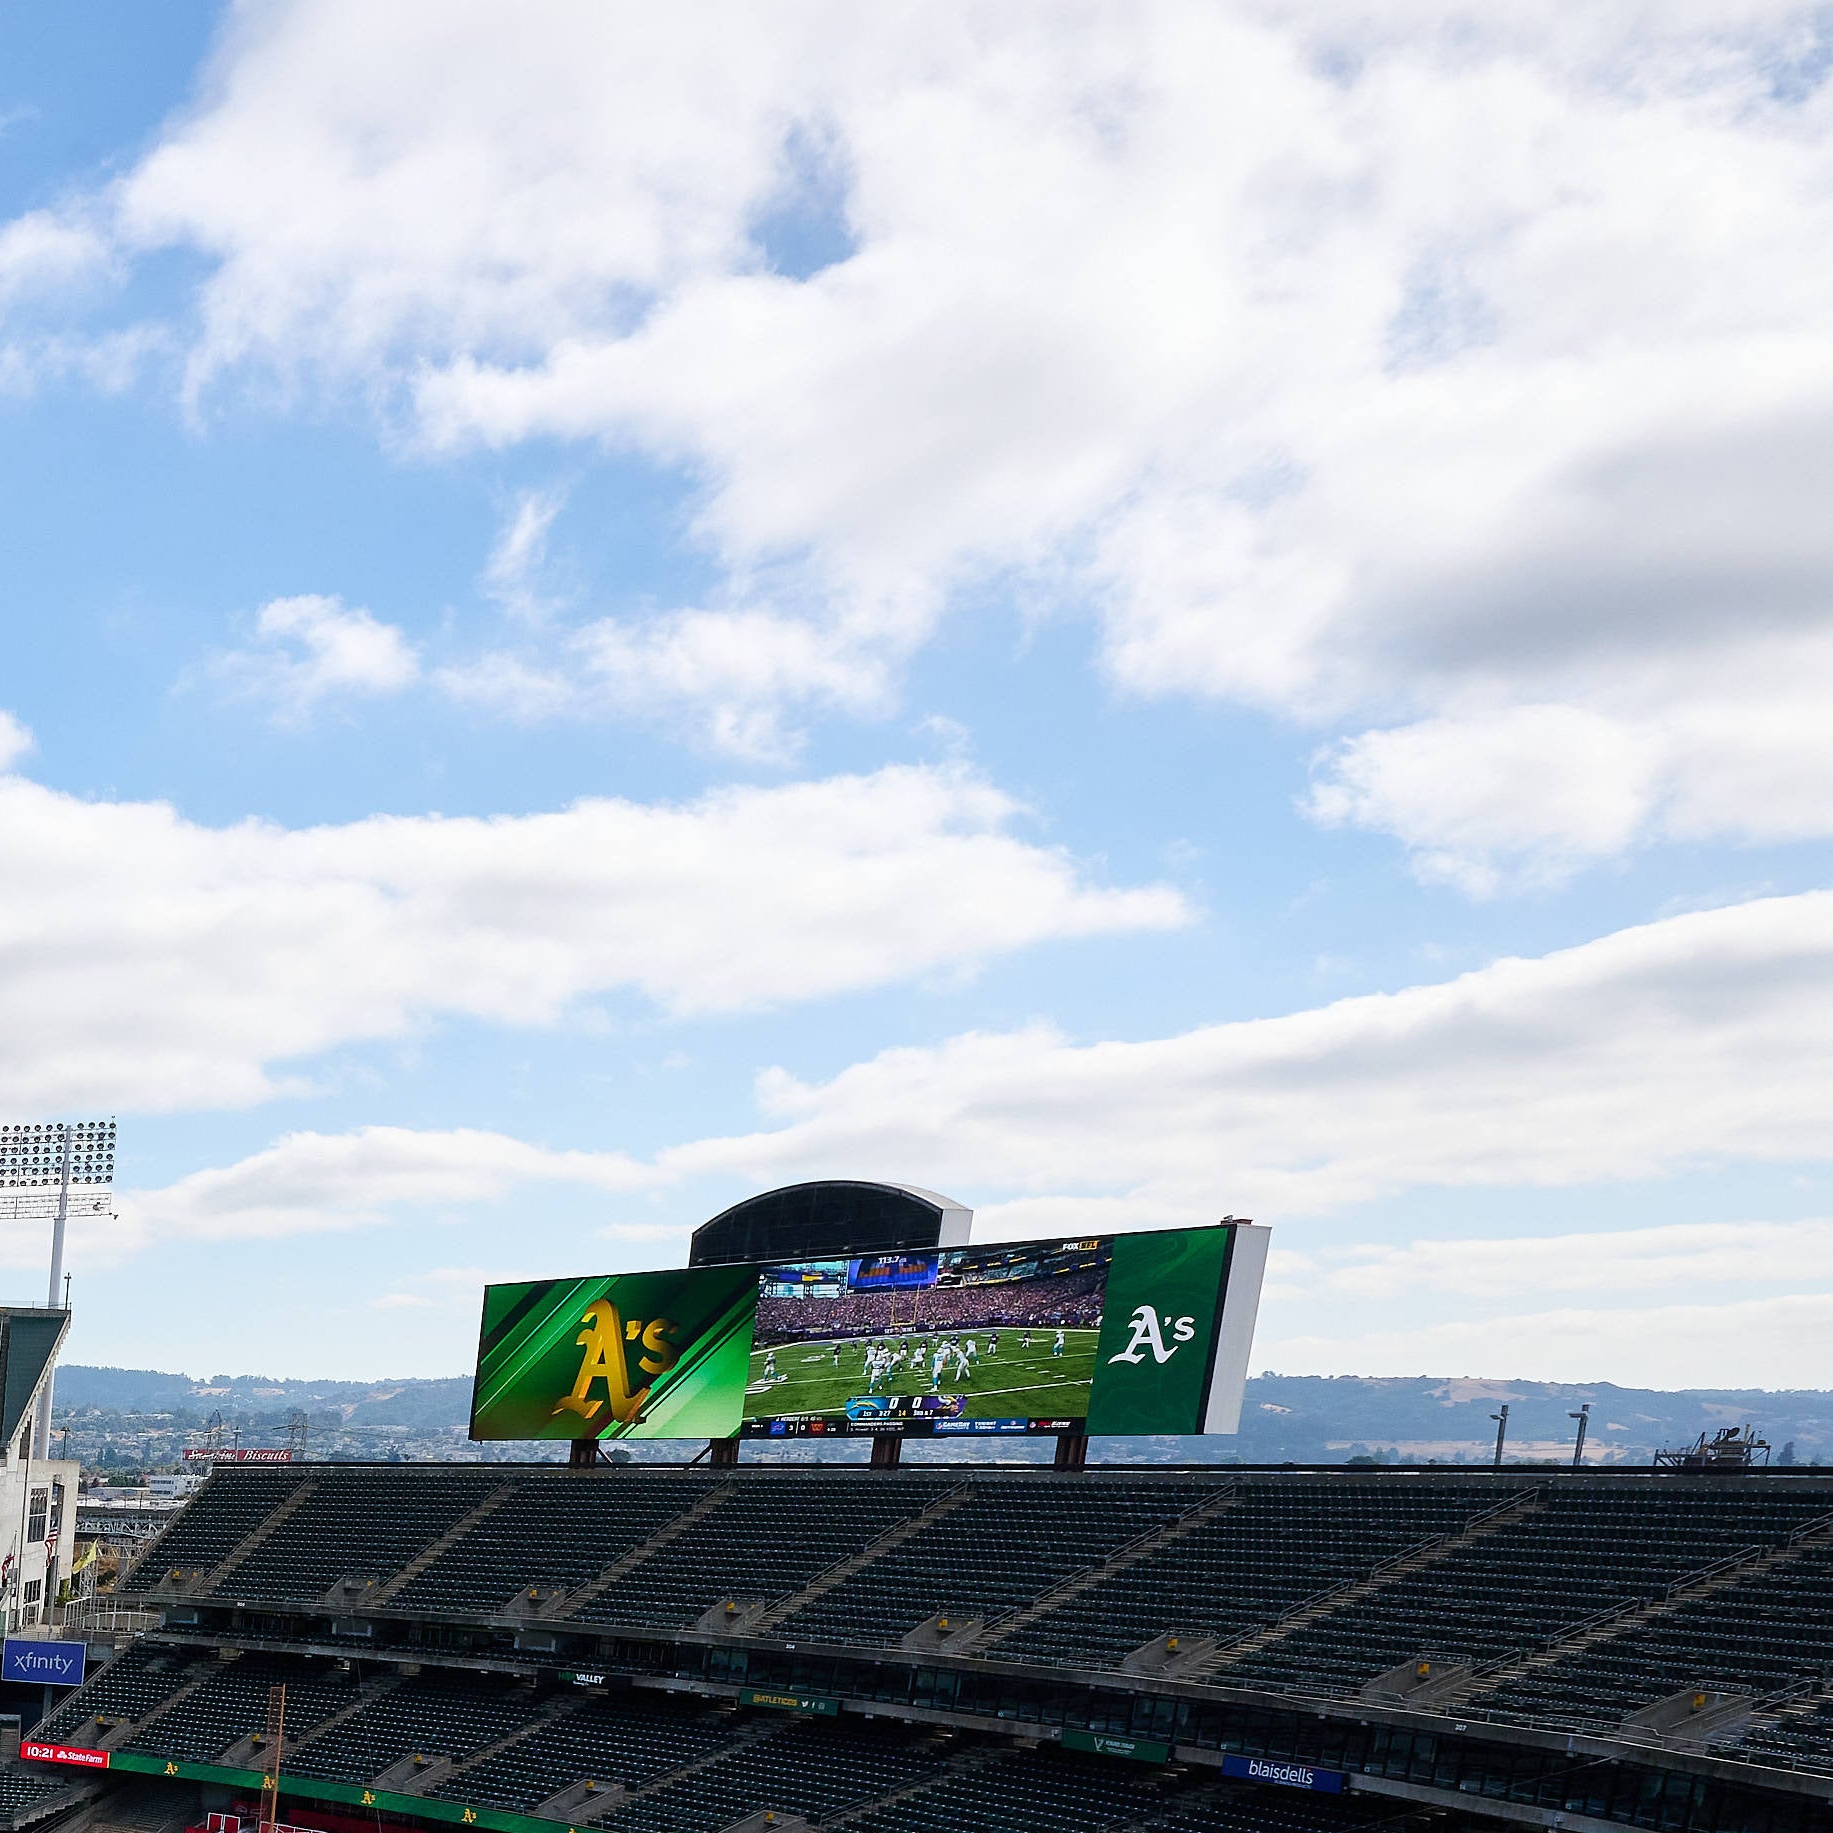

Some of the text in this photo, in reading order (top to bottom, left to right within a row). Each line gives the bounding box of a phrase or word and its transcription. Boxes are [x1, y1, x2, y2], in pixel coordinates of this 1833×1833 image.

[1063, 1242, 1079, 1251] FOX
[1108, 1305, 1196, 1365] A's
[552, 1298, 678, 1424] A's
[889, 1396, 921, 1409] 0 0
[14, 1651, 73, 1674] xfinity
[26, 1746, 53, 1759] 10:21
[1248, 1760, 1314, 1785] blaisdells
